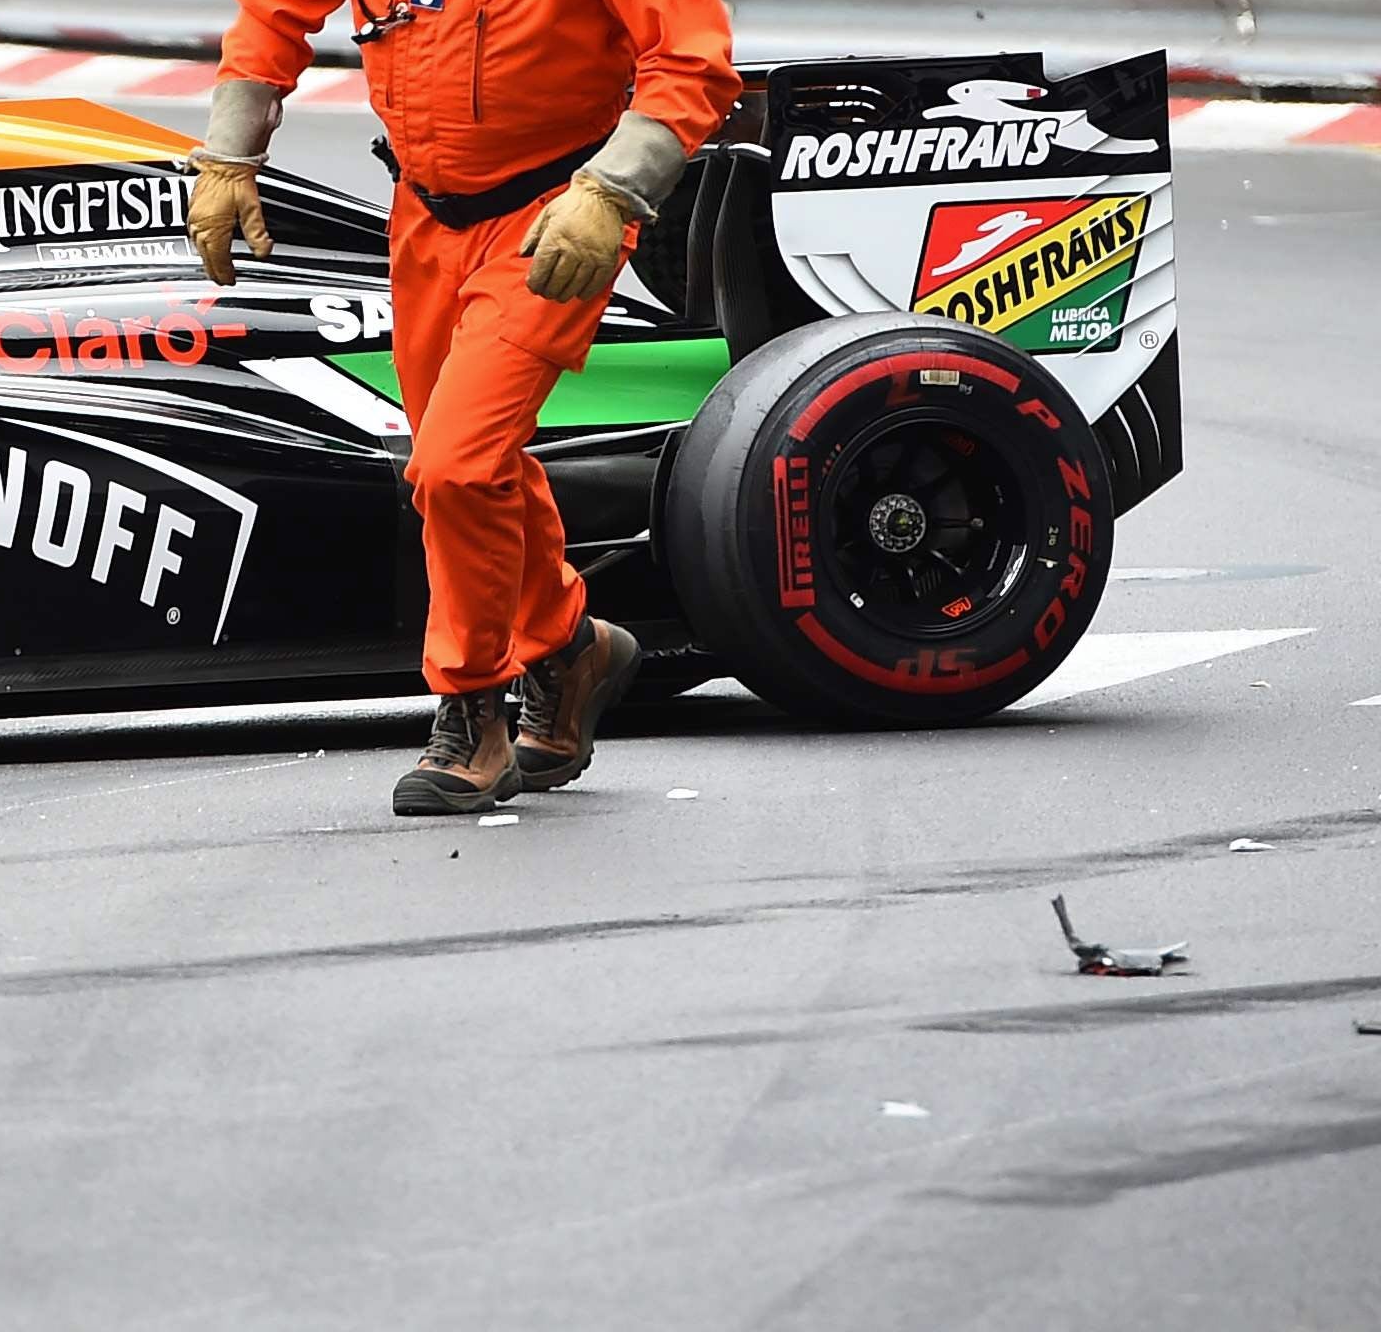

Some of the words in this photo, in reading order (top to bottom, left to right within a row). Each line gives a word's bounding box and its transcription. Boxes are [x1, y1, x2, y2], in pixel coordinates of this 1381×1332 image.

[780, 120, 1060, 180] ROSHFRANS
[49, 241, 175, 262] PREMIUM
[1052, 307, 1110, 323] LUBRICA
[1049, 323, 1112, 342] MEJOR
[1015, 398, 1062, 431] P
[773, 454, 817, 608] PIRELLI
[1033, 455, 1094, 651] ZERO
